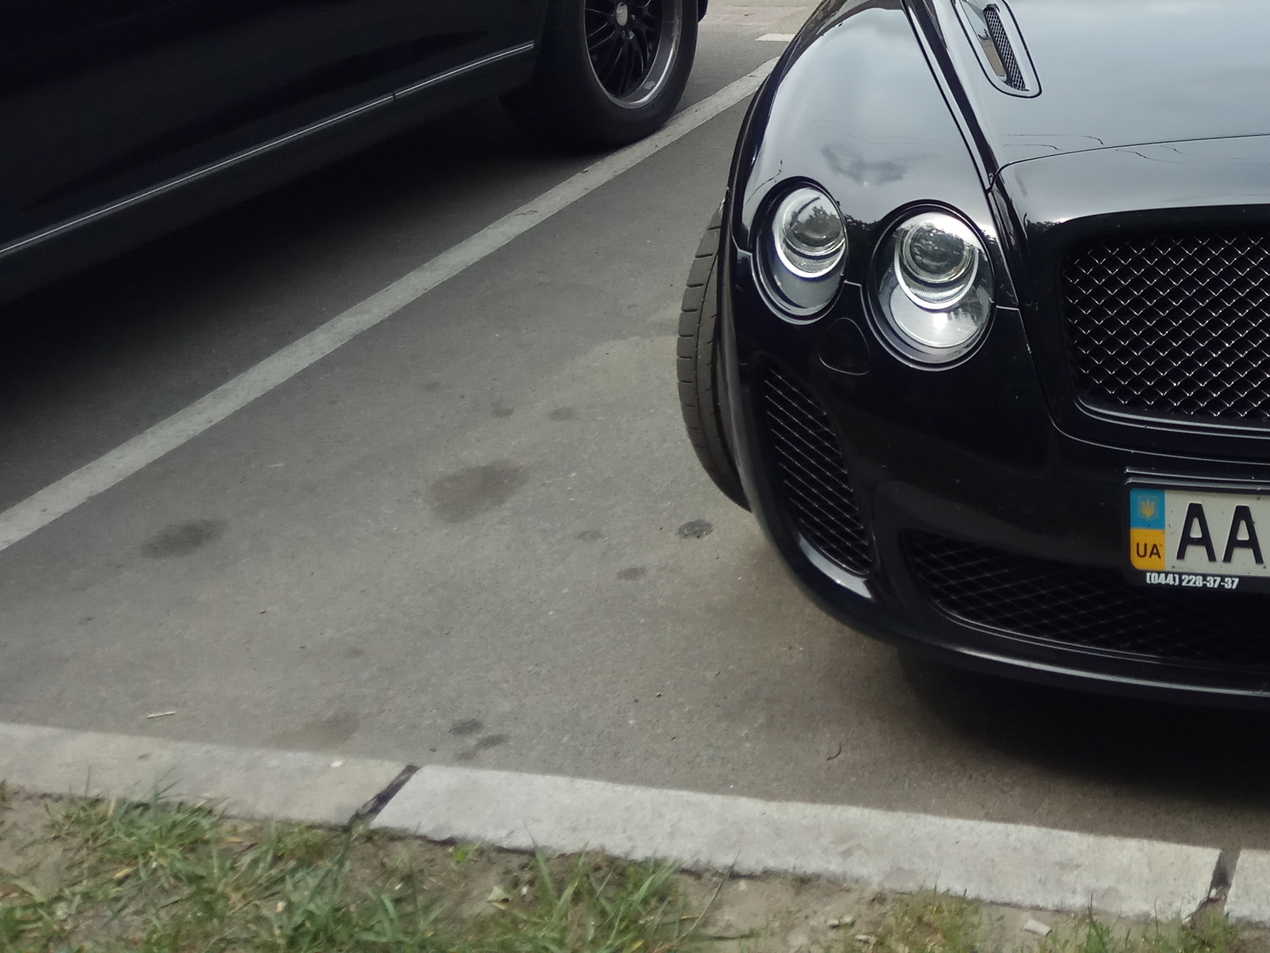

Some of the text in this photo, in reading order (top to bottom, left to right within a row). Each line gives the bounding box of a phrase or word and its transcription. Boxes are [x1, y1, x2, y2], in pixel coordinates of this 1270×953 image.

[1136, 542, 1161, 559] UA
[1176, 502, 1264, 565] AA
[1146, 572, 1240, 589] (044) 228-37-37
